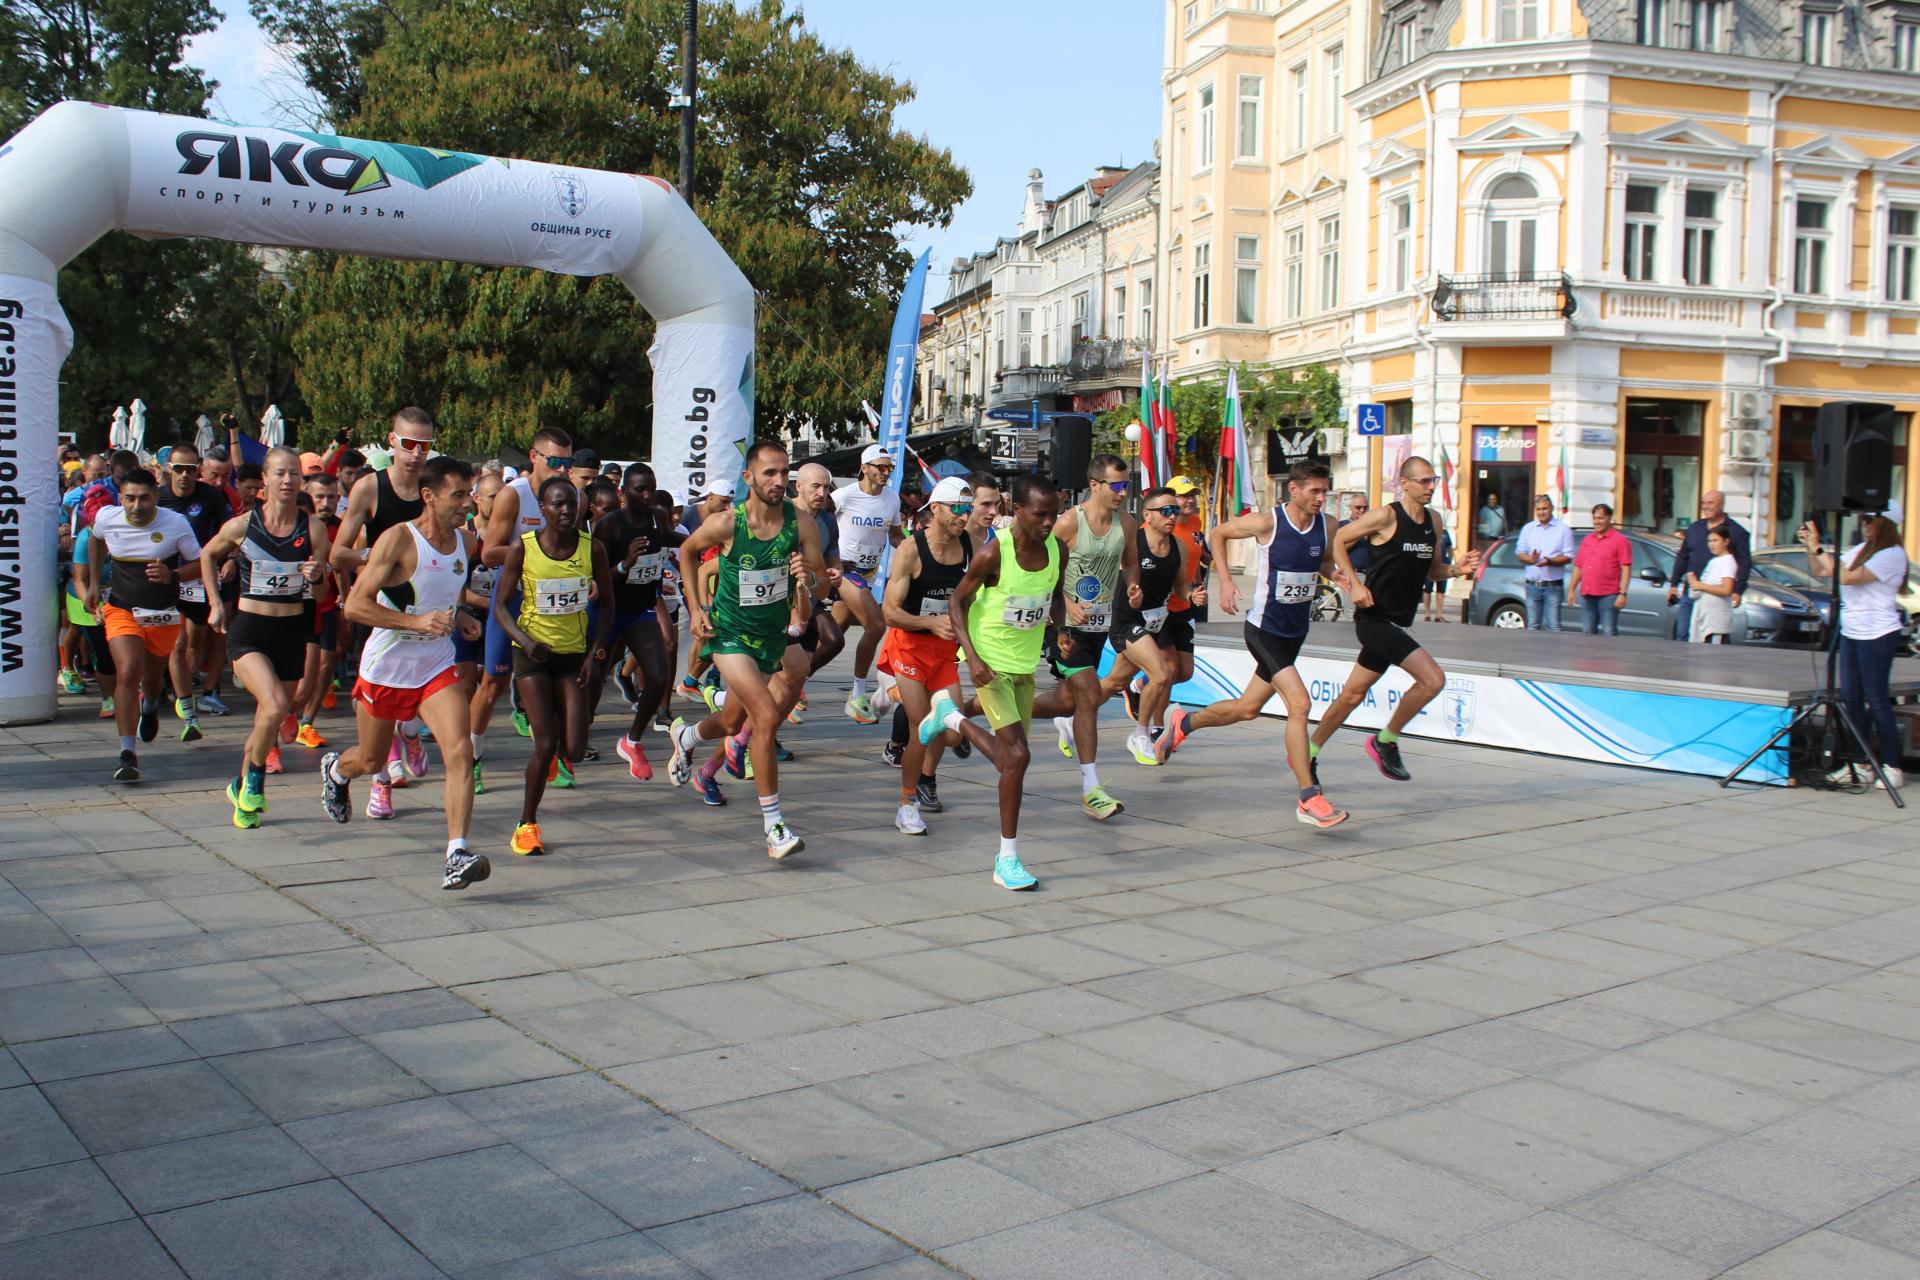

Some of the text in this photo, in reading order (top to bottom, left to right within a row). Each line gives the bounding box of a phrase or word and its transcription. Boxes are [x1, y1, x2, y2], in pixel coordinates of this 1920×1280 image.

[176, 130, 384, 196] ЯКО
[160, 187, 404, 219] спорт и туризъм
[531, 222, 612, 239] ОБЩИНА РУСЕ
[859, 554, 878, 564] 255
[636, 566, 658, 580] 153
[267, 575, 289, 589] 42
[755, 583, 776, 598] 97
[1284, 586, 1310, 597] 239
[547, 593, 580, 607] 154
[143, 613, 173, 624] 250
[1013, 608, 1044, 623] 150
